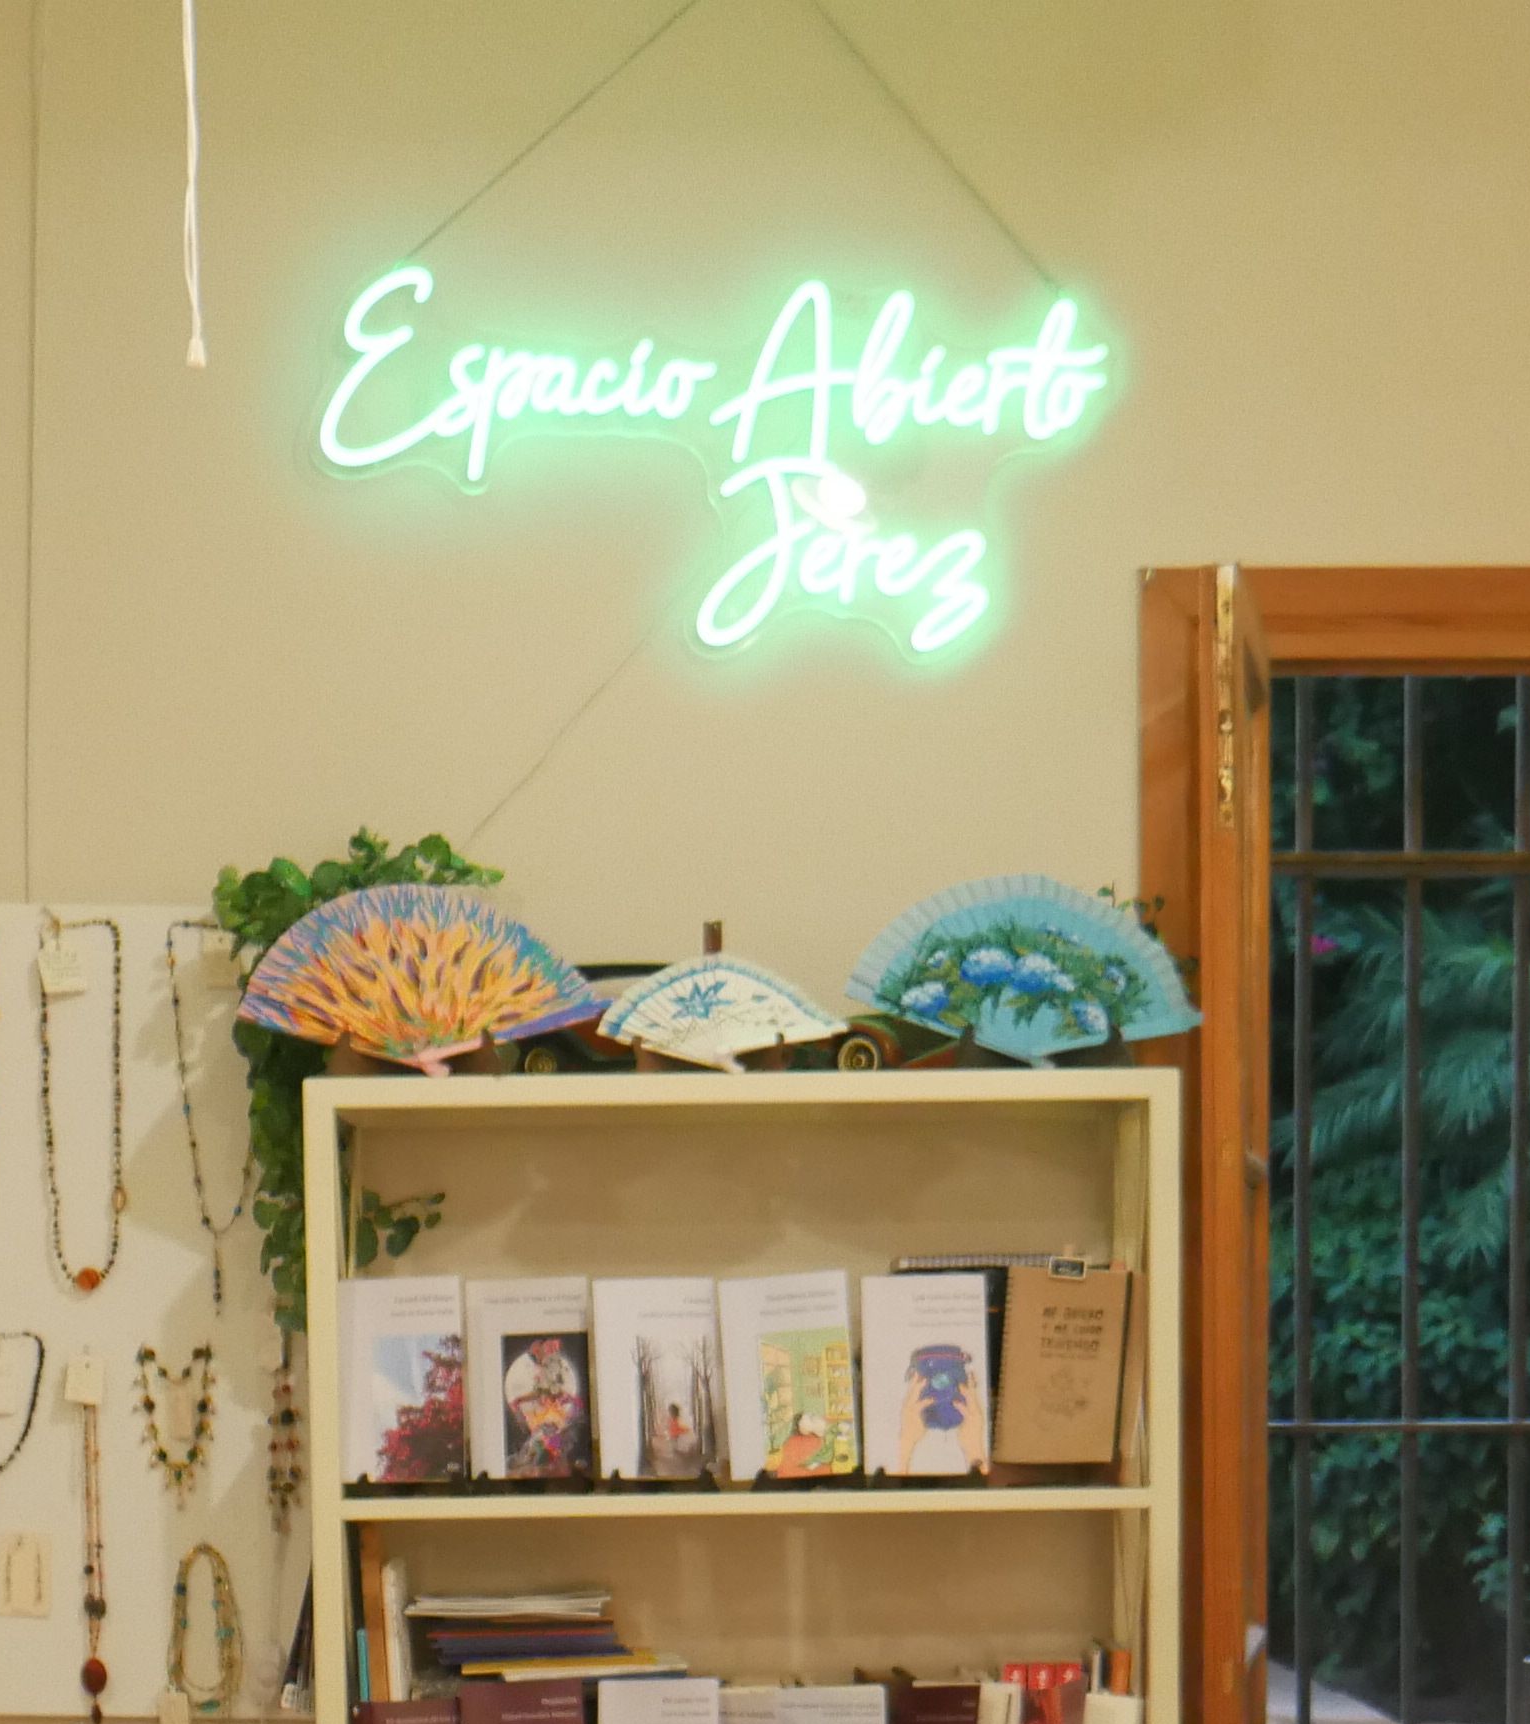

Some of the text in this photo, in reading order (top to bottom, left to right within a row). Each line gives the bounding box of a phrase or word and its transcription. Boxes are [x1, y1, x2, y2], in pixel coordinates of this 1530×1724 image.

[319, 265, 1110, 484] Espacio Abierto
[695, 456, 989, 654] Jerez
